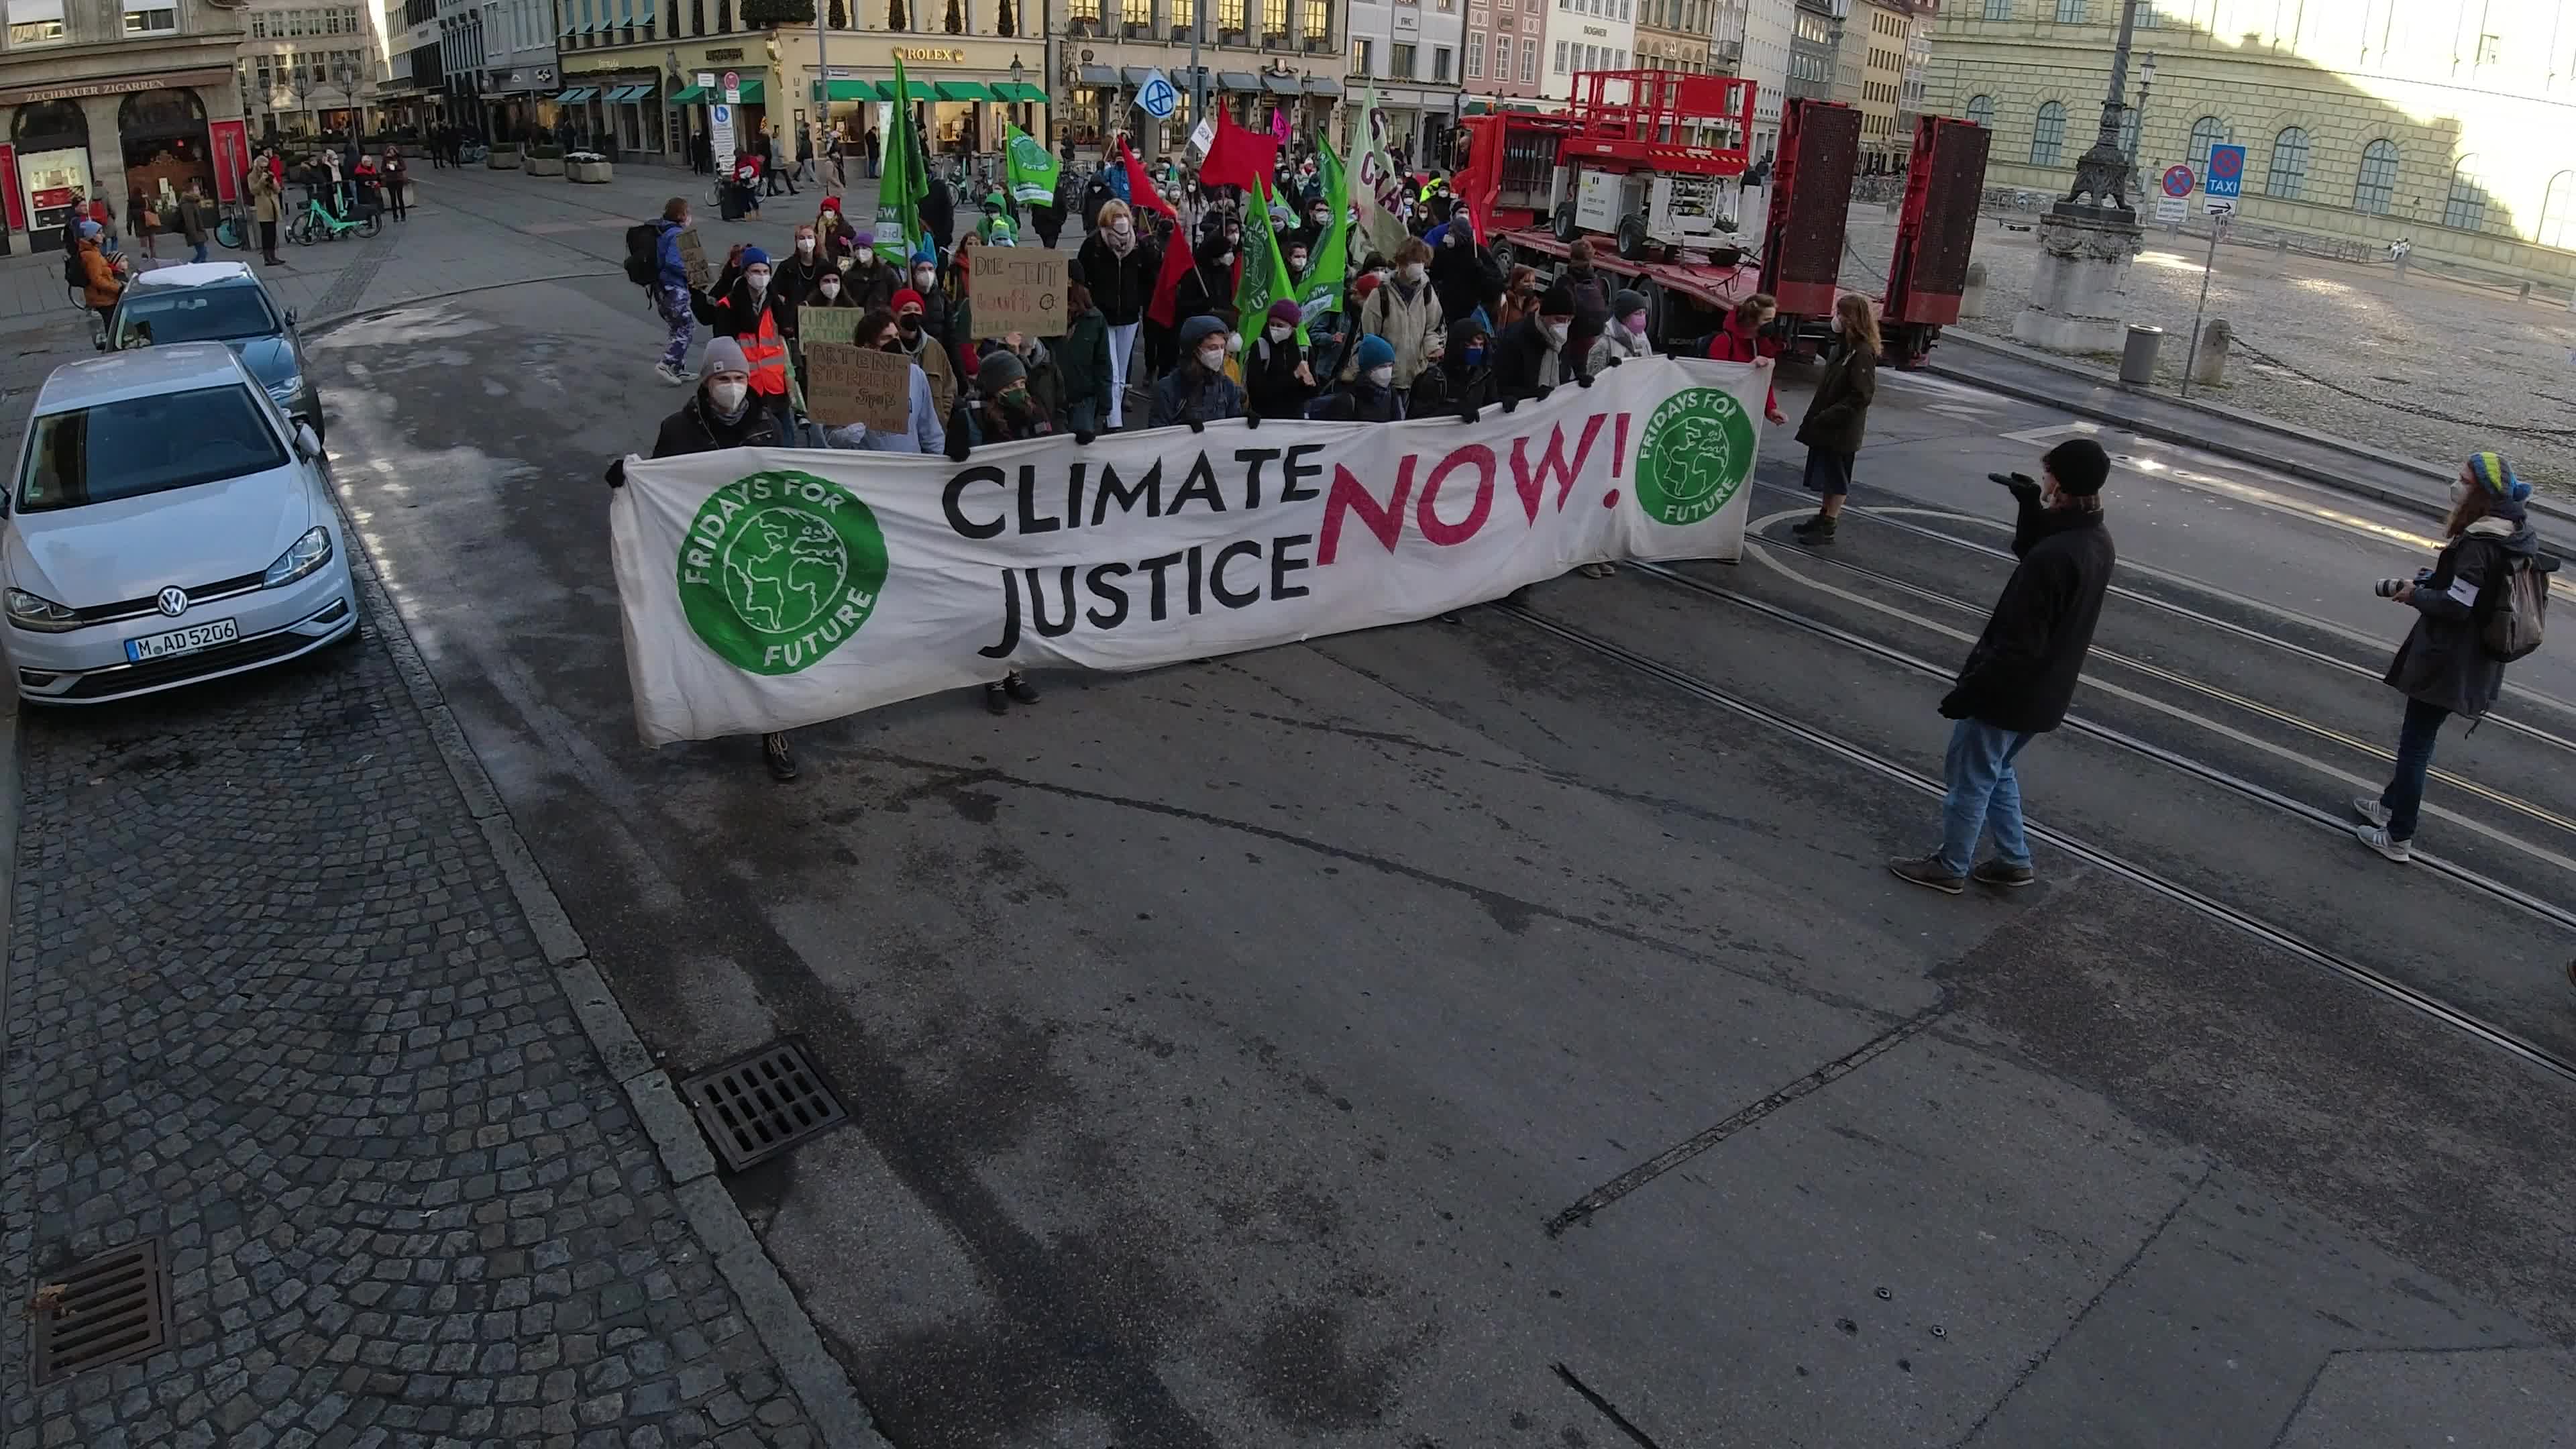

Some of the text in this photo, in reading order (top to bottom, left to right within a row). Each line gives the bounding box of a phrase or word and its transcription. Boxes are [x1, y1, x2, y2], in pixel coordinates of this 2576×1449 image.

[906, 48, 951, 61] ROLEX
[27, 79, 165, 102] ZECHBAUER ZIGARREN
[2209, 179, 2238, 194] TAXI
[975, 256, 1004, 276] DIE
[1640, 392, 1698, 460] FRIDAYS
[942, 443, 1326, 540] CLIMATE
[1317, 412, 1631, 568] NOW!
[1664, 476, 1737, 522] FUTURE
[685, 478, 846, 584] FRIDAYS FOR
[977, 536, 1313, 659] JUSTICE
[138, 623, 234, 657] M AD 5206
[763, 587, 873, 667] FUTURE
